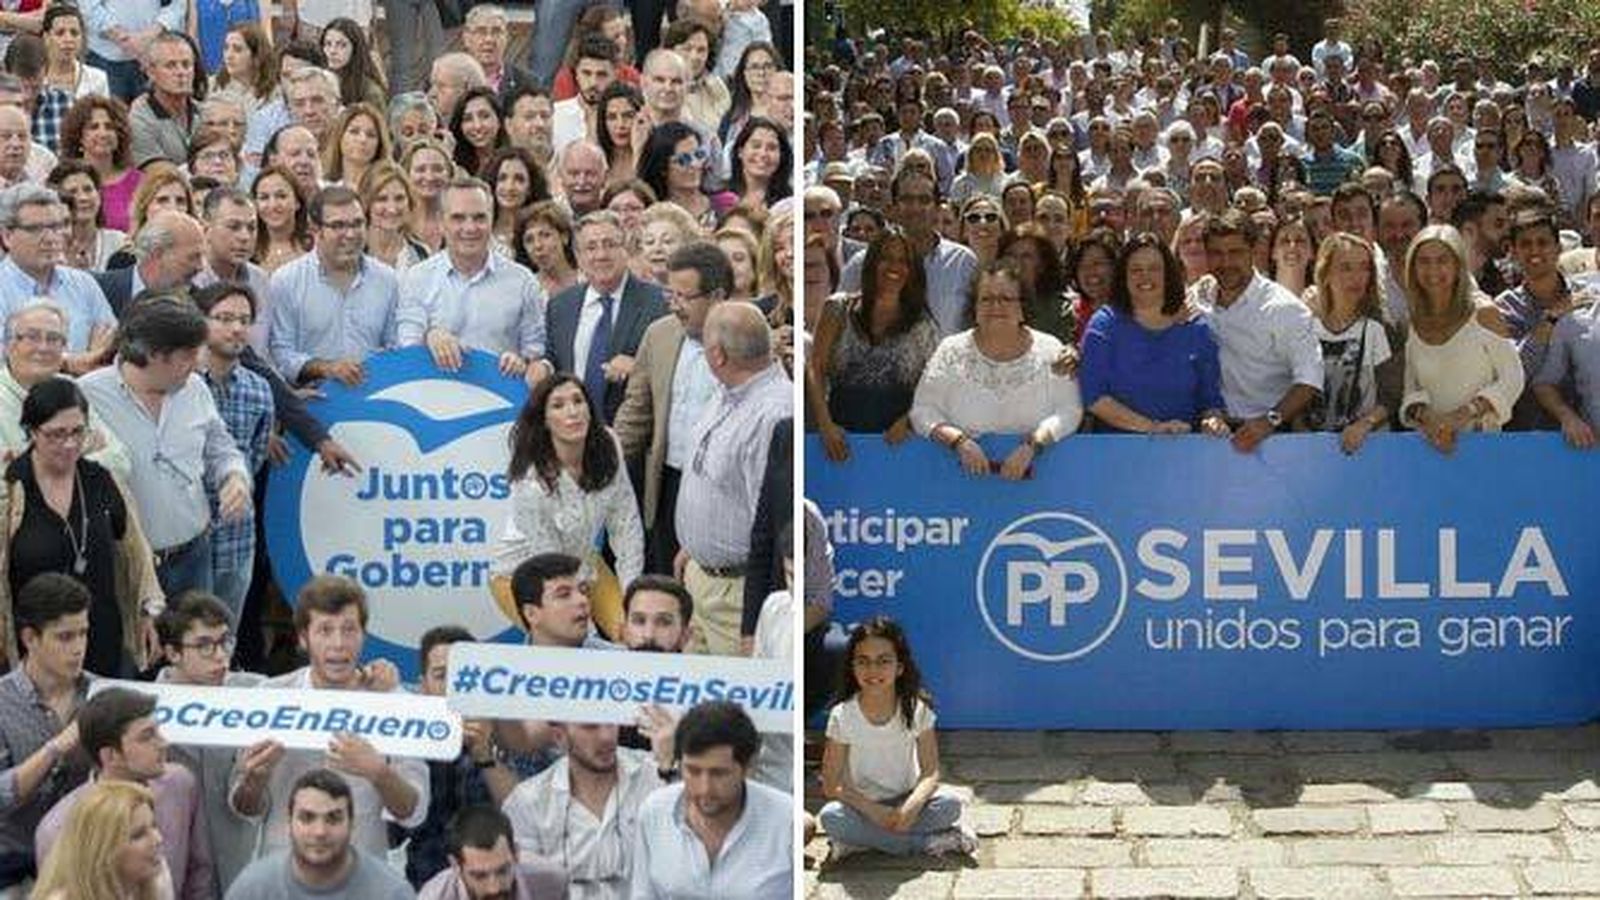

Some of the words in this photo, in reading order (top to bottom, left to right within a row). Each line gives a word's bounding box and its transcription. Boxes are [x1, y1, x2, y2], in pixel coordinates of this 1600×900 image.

[357, 467, 510, 501] Juntos
[384, 516, 486, 549] para
[1135, 526, 1569, 600] SEVILLA
[1007, 560, 1099, 626] PP
[1146, 608, 1302, 650] unidos
[1319, 613, 1421, 657] para
[1437, 613, 1574, 657] ganar
[454, 664, 794, 711] #CreemosEnSevil
